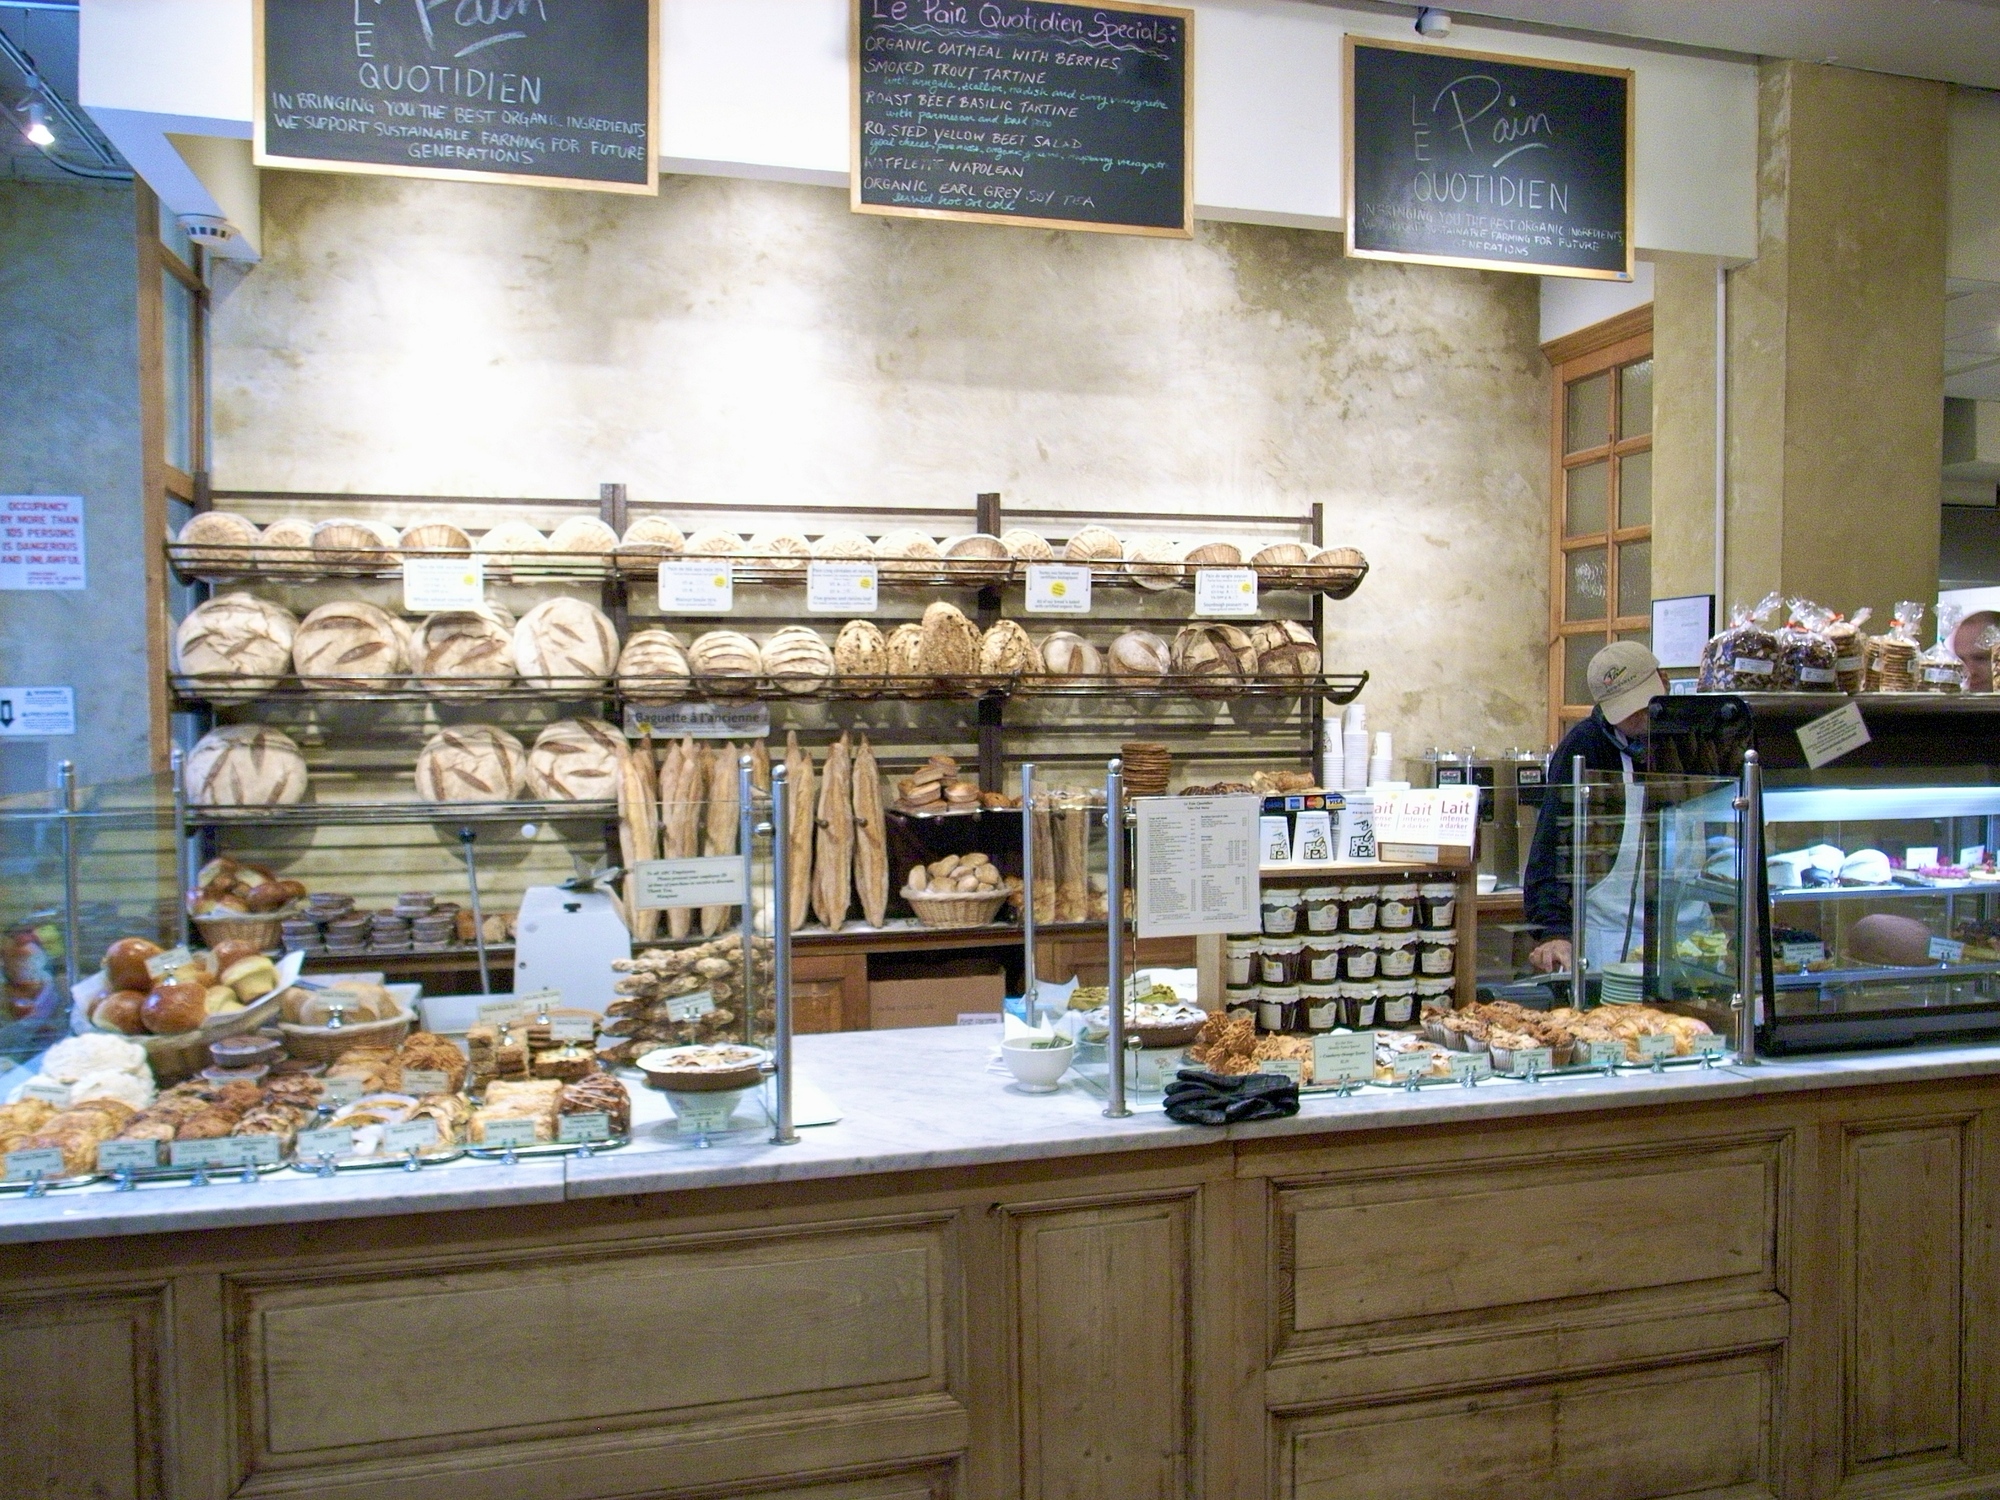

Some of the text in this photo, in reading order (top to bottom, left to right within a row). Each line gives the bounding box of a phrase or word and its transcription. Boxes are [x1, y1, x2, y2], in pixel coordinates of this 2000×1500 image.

[872, 0, 908, 21] Le
[922, 0, 968, 25] Pain
[978, 2, 1084, 35] Quotidien
[865, 36, 1121, 70] ORGANIC OATMEAL WITH BERRIES
[863, 58, 1047, 85] SMOKED TROUT TARTINE
[358, 62, 542, 105] QUOTIDIEN
[273, 92, 293, 110] IN
[298, 93, 374, 115] BRINGING
[384, 100, 415, 118] YOU
[420, 104, 449, 120] THE
[455, 106, 497, 125] BEST
[566, 114, 646, 138] INGREDIENTS
[865, 91, 1079, 118] ROAST BEEF BASILIC TARTINE
[1433, 74, 1552, 154] Pain
[978, 115, 1000, 124] and
[274, 113, 645, 161] WE SUPPORT SUSTAINABLE FARMING FOR FUTURE
[934, 128, 985, 144] YELLOW
[992, 133, 1027, 146] BEET
[1034, 136, 1082, 149] SALAD
[408, 142, 534, 165] GENERATIONS
[948, 161, 1024, 178] NAPOLEAN
[863, 177, 928, 192] ORGANIC
[939, 183, 977, 196] EARL
[984, 185, 1023, 199] GREY
[1413, 171, 1568, 214] QUOTIDIEN
[938, 195, 963, 206] hot
[1438, 212, 1461, 227] YOU
[1466, 214, 1485, 228] THE
[1518, 220, 1564, 237] ORGANIC
[1491, 230, 1531, 244] FARMING
[1534, 236, 1553, 247] FOR
[1558, 238, 1600, 252] FUTURE
[8, 502, 68, 511] OCCUPANCY
[18, 515, 46, 524] MORE
[51, 515, 79, 524] THAN
[28, 528, 76, 538] PERSONS
[17, 542, 78, 551] DANGEROUS
[26, 555, 80, 564] UNLAWFUL
[635, 712, 760, 725] Baguette à l'ancienne
[1374, 802, 1394, 814] ait
[1404, 803, 1432, 815] Lait
[1440, 814, 1469, 822] intense
[1441, 800, 1470, 815] Lait
